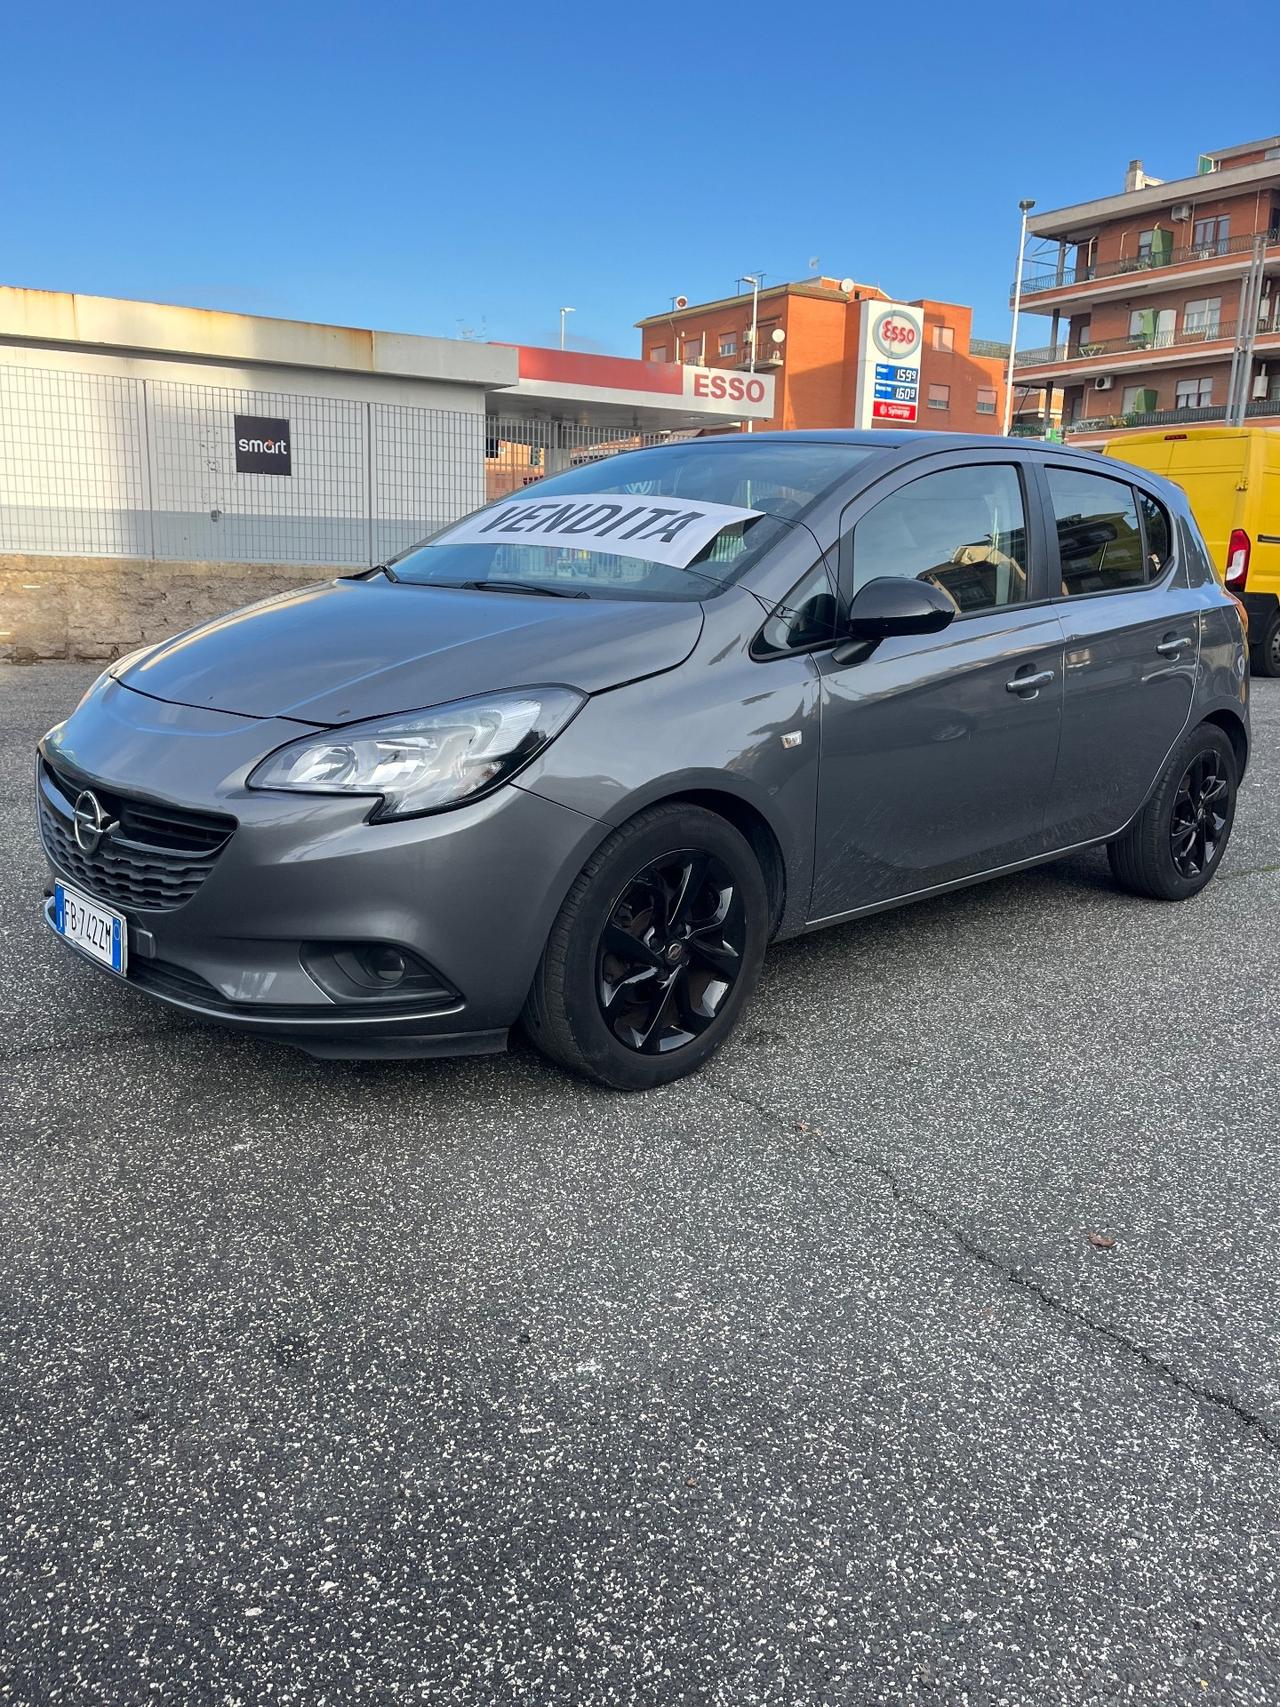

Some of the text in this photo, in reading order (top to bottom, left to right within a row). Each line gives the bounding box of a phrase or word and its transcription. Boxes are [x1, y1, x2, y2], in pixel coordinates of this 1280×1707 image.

[694, 373, 765, 403] ESSO
[238, 438, 288, 455] smart
[479, 503, 706, 543] VENDITA
